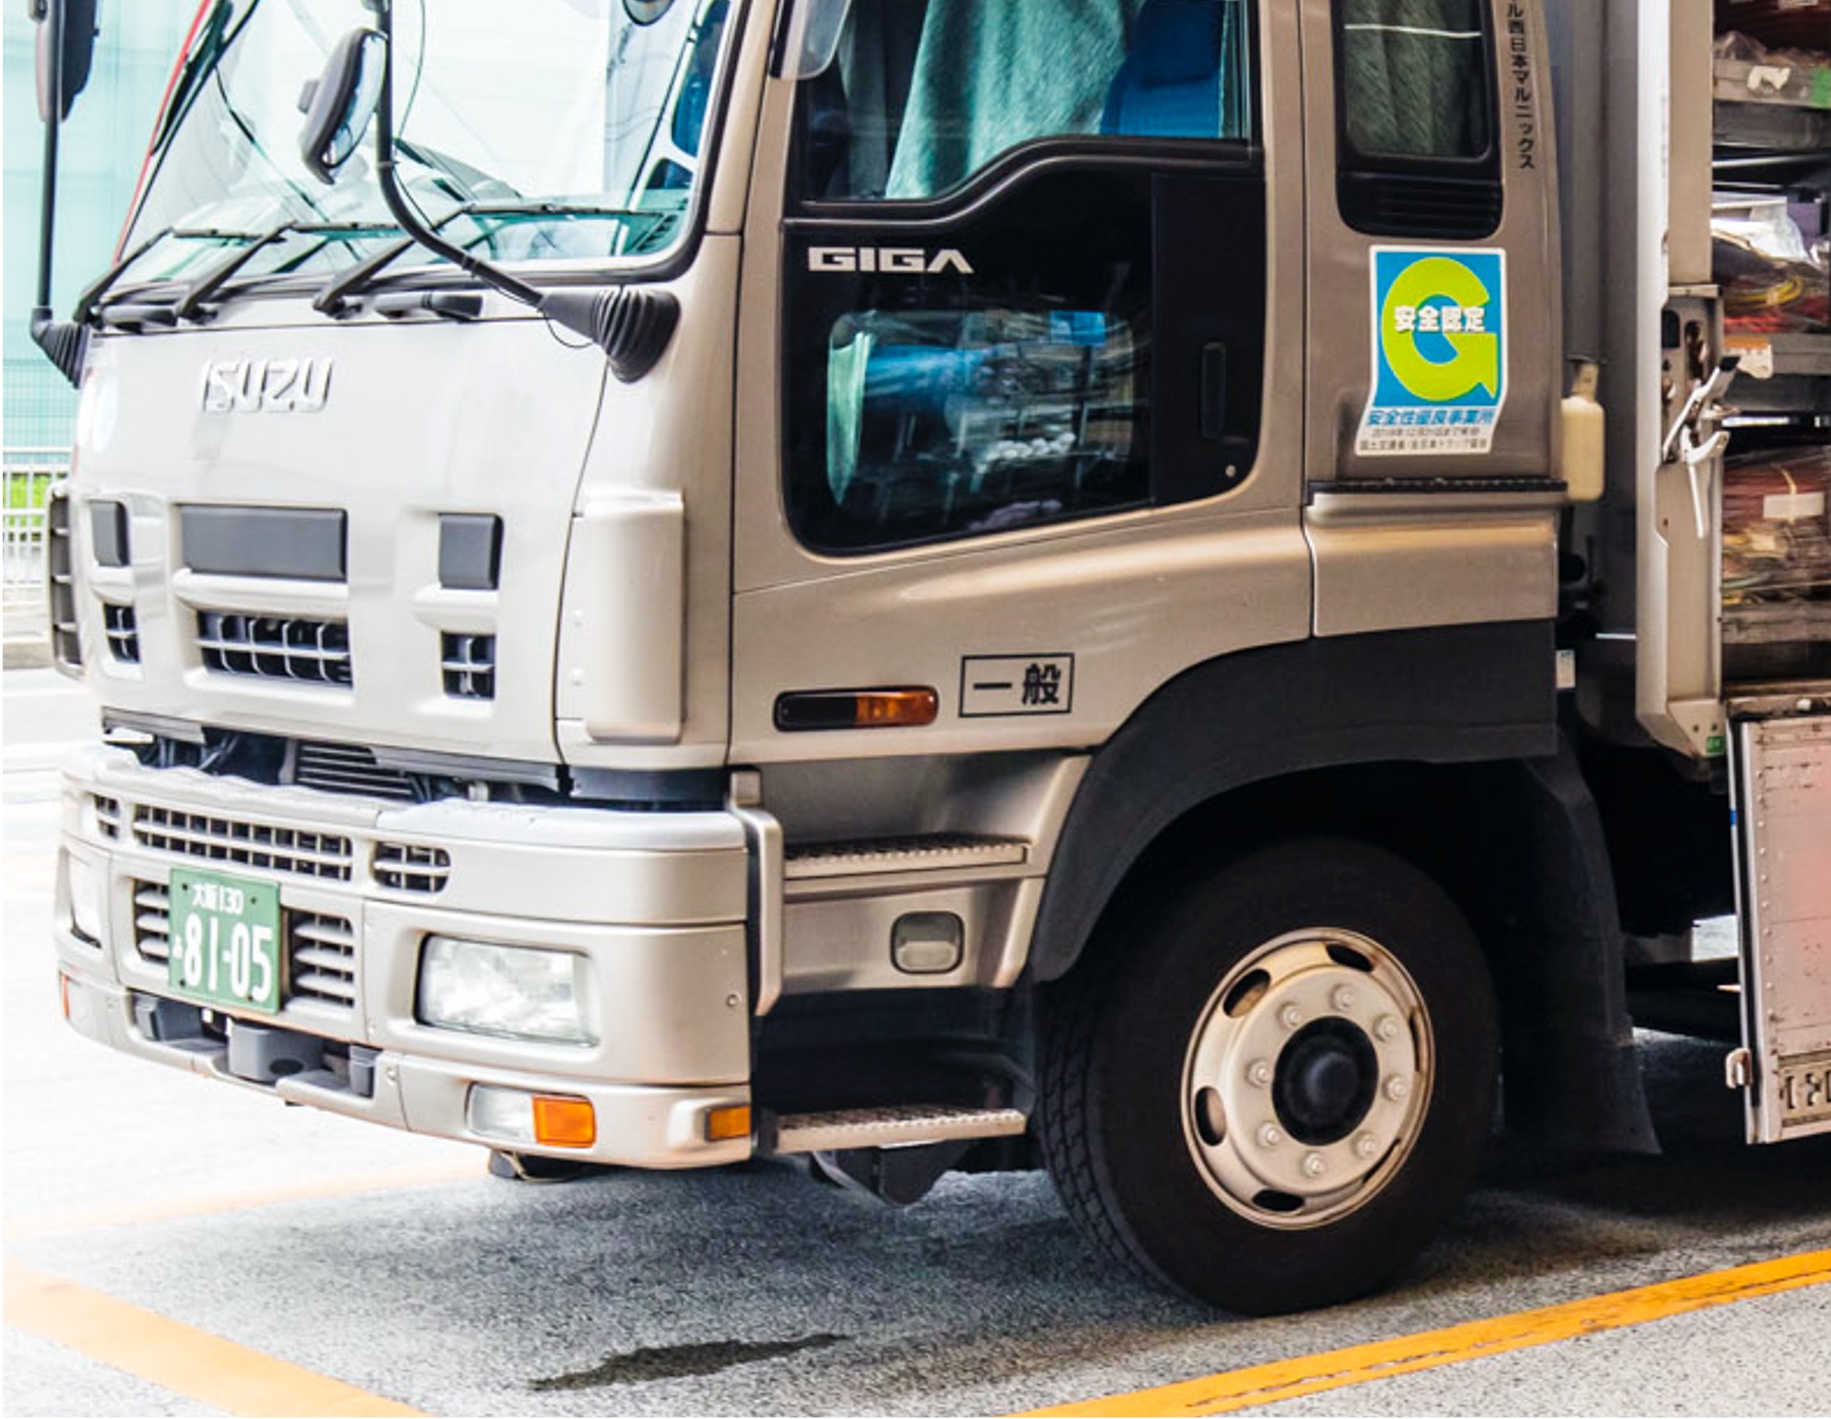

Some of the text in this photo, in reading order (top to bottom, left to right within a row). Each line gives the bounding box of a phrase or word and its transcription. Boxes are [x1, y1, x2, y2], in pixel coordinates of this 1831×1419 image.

[807, 246, 973, 274] GIGA
[1393, 304, 1486, 333] 安全認定
[201, 357, 333, 413] ISUZU
[972, 662, 1062, 706] 一般
[184, 913, 273, 1002] 81-05
